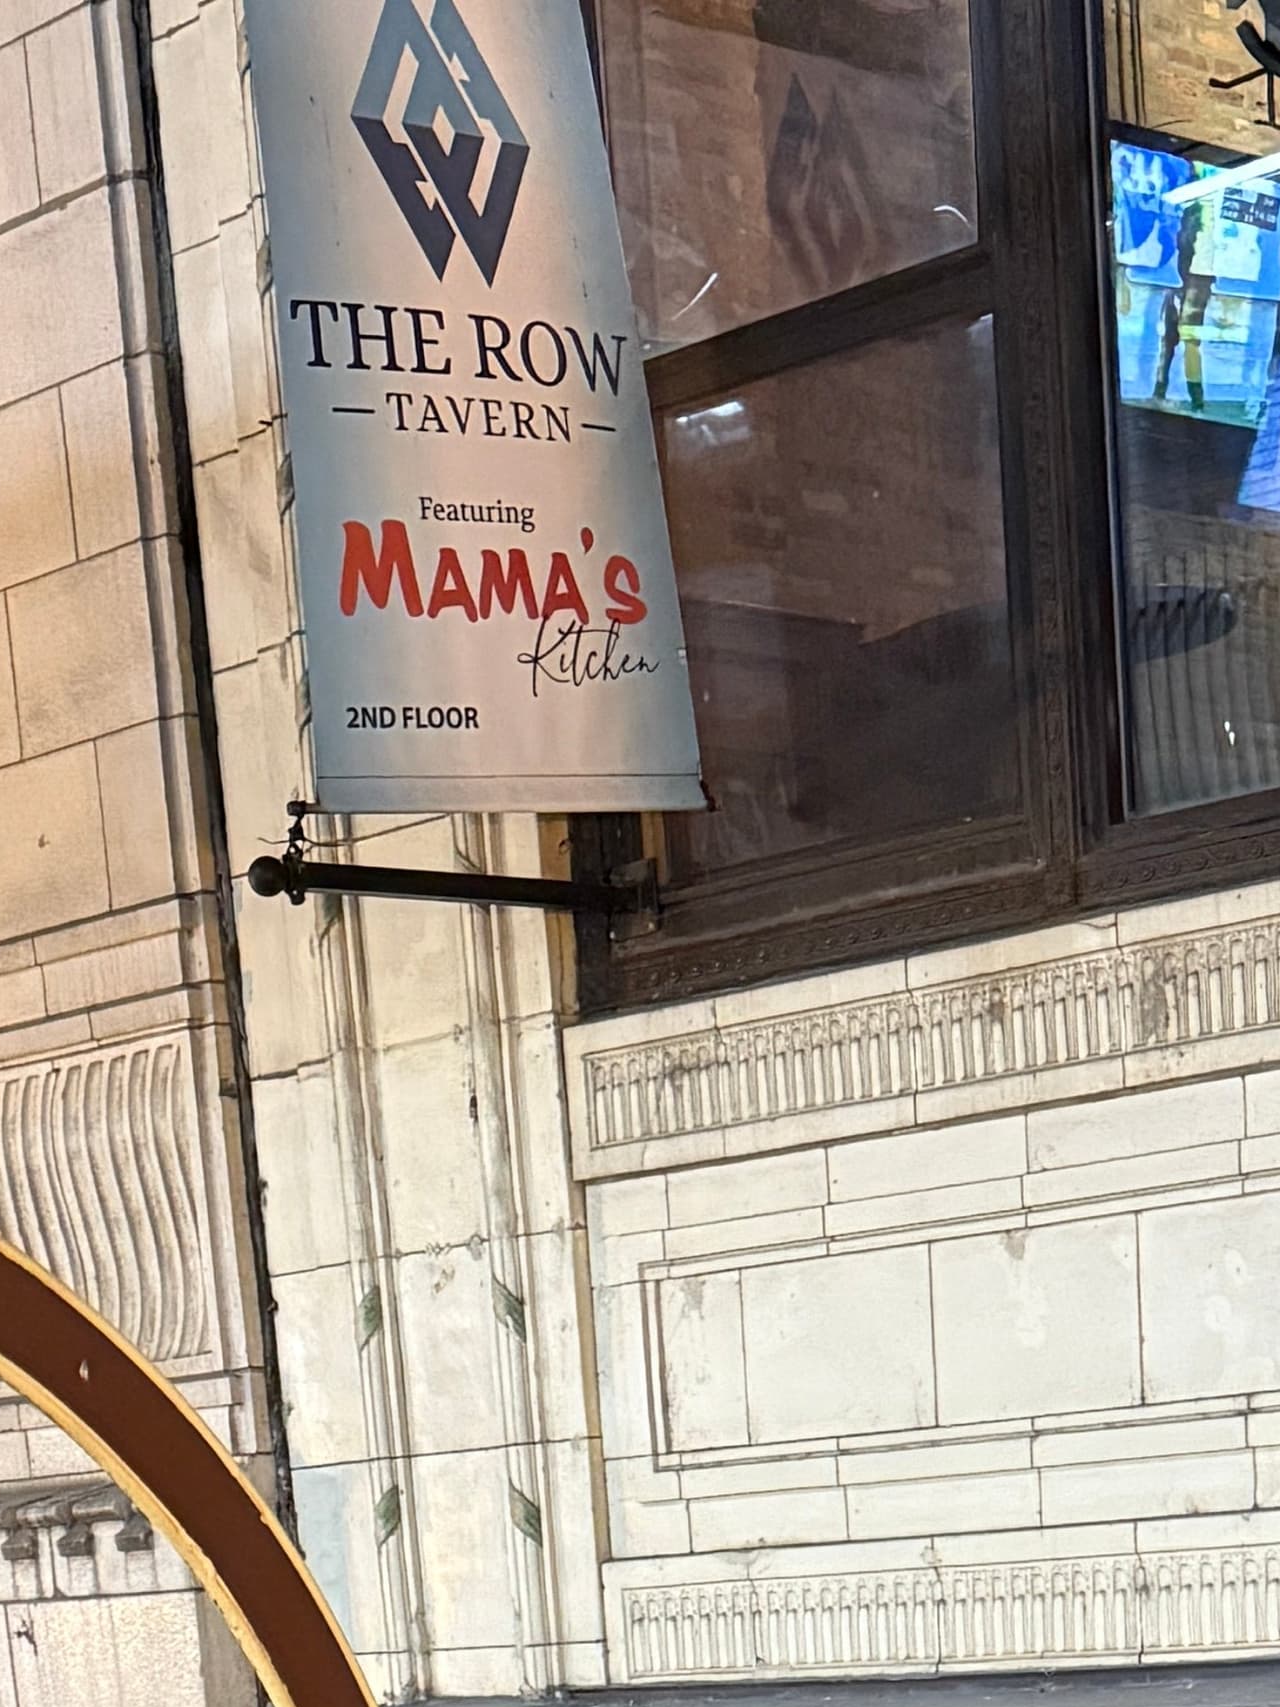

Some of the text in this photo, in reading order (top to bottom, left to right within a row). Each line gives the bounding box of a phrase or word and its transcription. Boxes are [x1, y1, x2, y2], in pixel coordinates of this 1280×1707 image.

[290, 299, 628, 397] THE ROW
[385, 392, 570, 443] TAVERN
[418, 496, 536, 533] Featuring
[339, 519, 648, 625] MAMA'S
[517, 614, 661, 697] Kitchen
[345, 706, 480, 730] 2ND FLOOR
